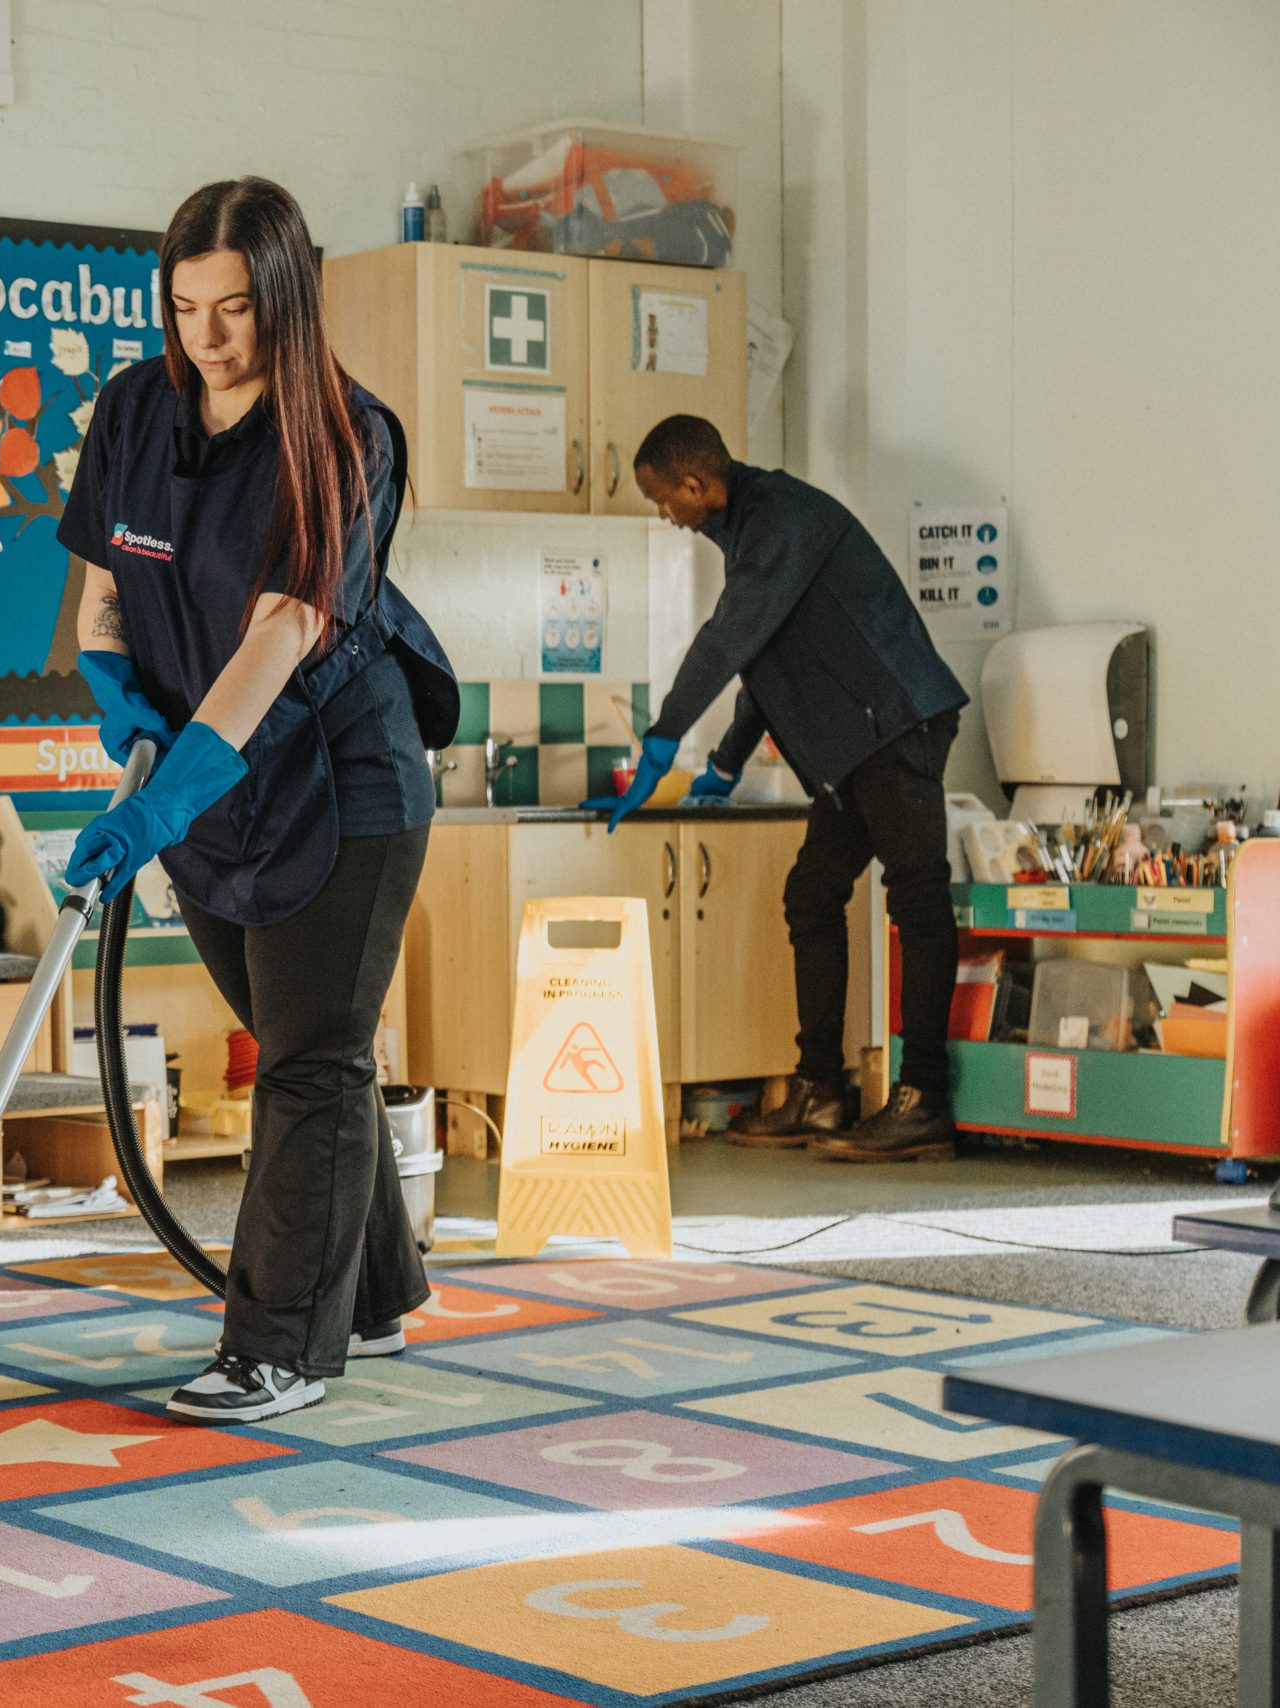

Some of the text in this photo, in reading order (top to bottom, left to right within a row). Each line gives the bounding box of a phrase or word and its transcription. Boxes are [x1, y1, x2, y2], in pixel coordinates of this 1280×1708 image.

[919, 524, 973, 540] CATCH IT
[919, 556, 954, 571] BIN IT
[920, 587, 960, 602] KILL IT
[543, 990, 556, 998] IN
[549, 1142, 618, 1151] HYGIENE
[770, 1301, 992, 1338] 13
[516, 1338, 754, 1380] 14
[539, 1438, 748, 1484] 8
[525, 1579, 771, 1643] 3
